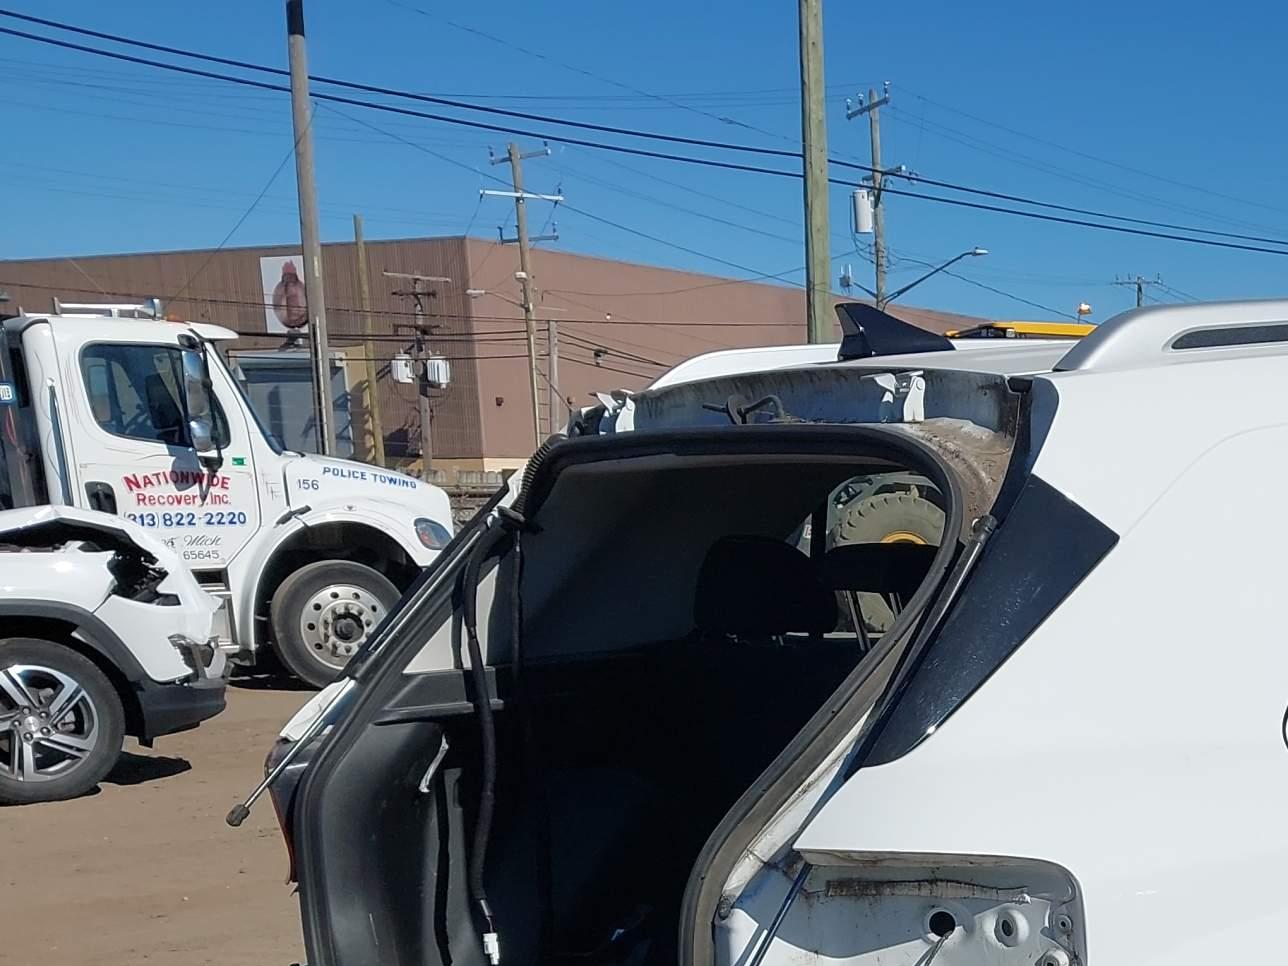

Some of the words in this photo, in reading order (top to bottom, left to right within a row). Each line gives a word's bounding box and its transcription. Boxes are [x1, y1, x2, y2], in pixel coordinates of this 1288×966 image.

[123, 470, 231, 491] NATIONWIDE
[322, 466, 367, 480] POLICE
[370, 473, 417, 488] TOWING
[298, 479, 319, 490] 156
[210, 492, 232, 505] Inc.
[183, 550, 220, 560] 65645
